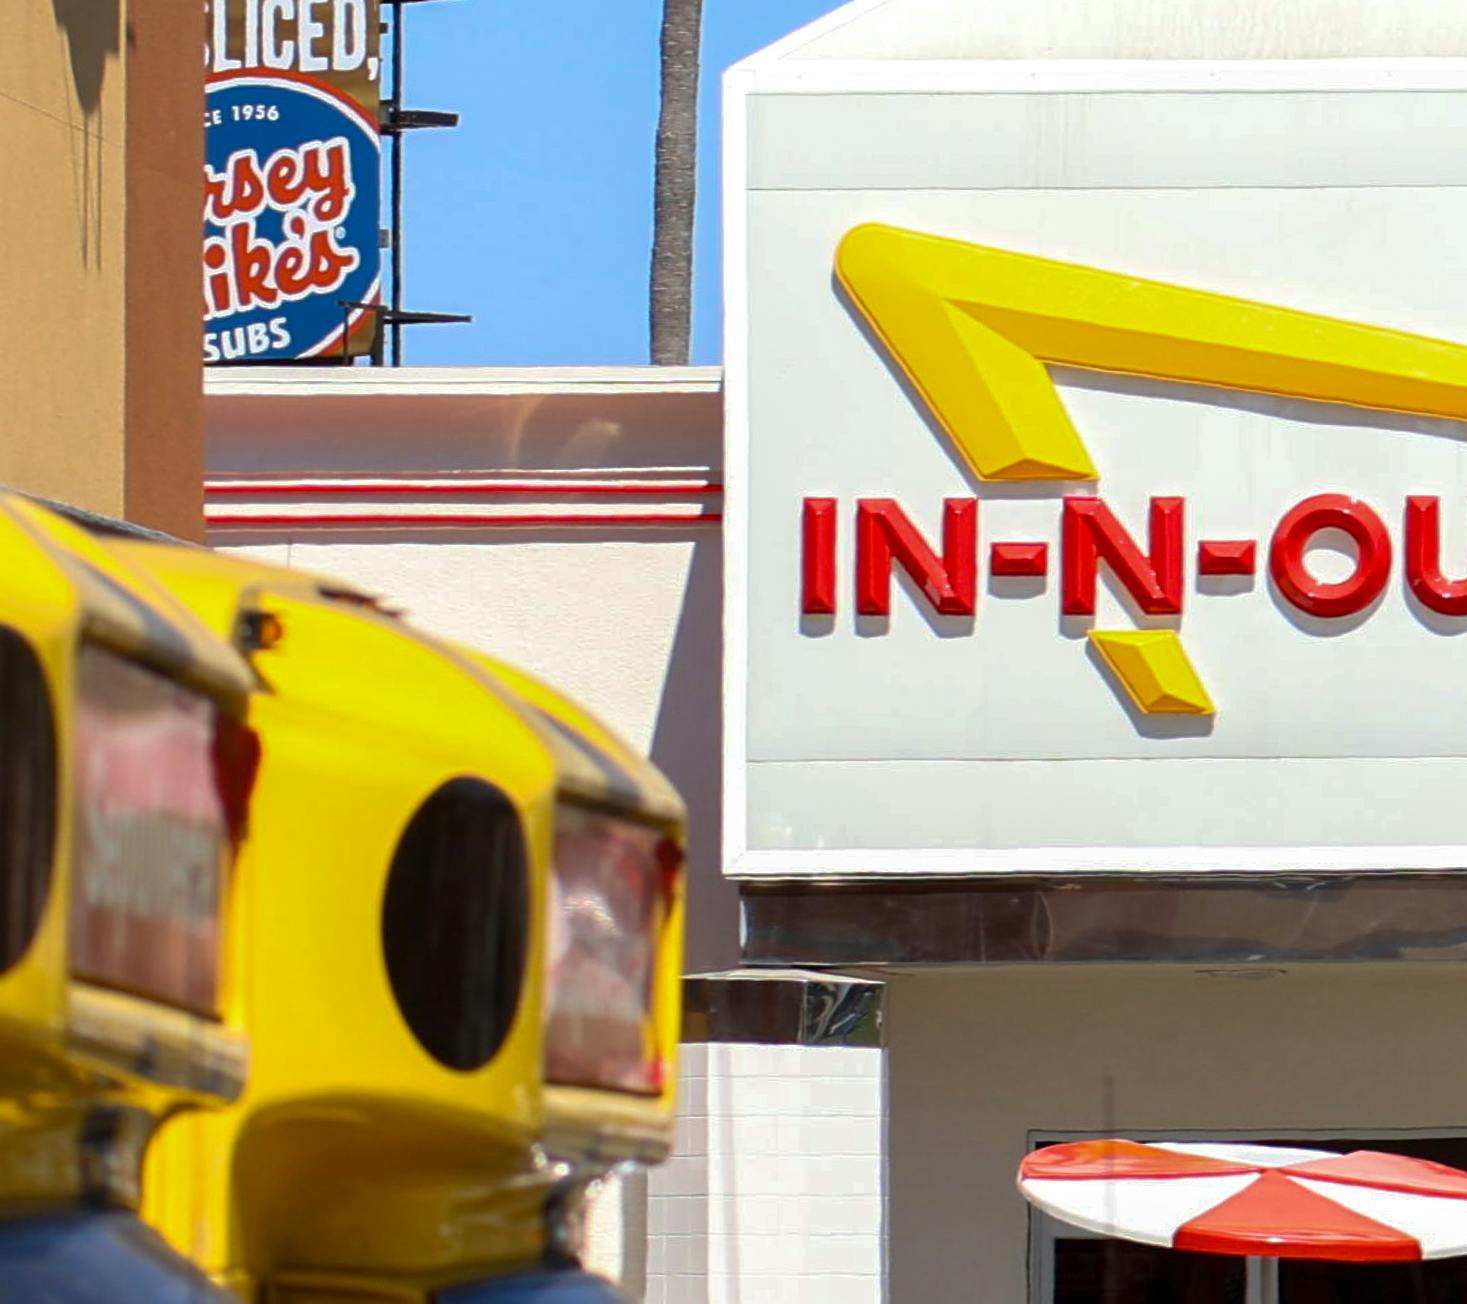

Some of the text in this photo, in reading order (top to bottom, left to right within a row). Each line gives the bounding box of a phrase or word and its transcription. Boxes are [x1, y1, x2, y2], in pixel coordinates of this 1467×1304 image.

[231, 104, 280, 122] 1956
[204, 214, 357, 316] ike's
[203, 317, 291, 362] SUBS
